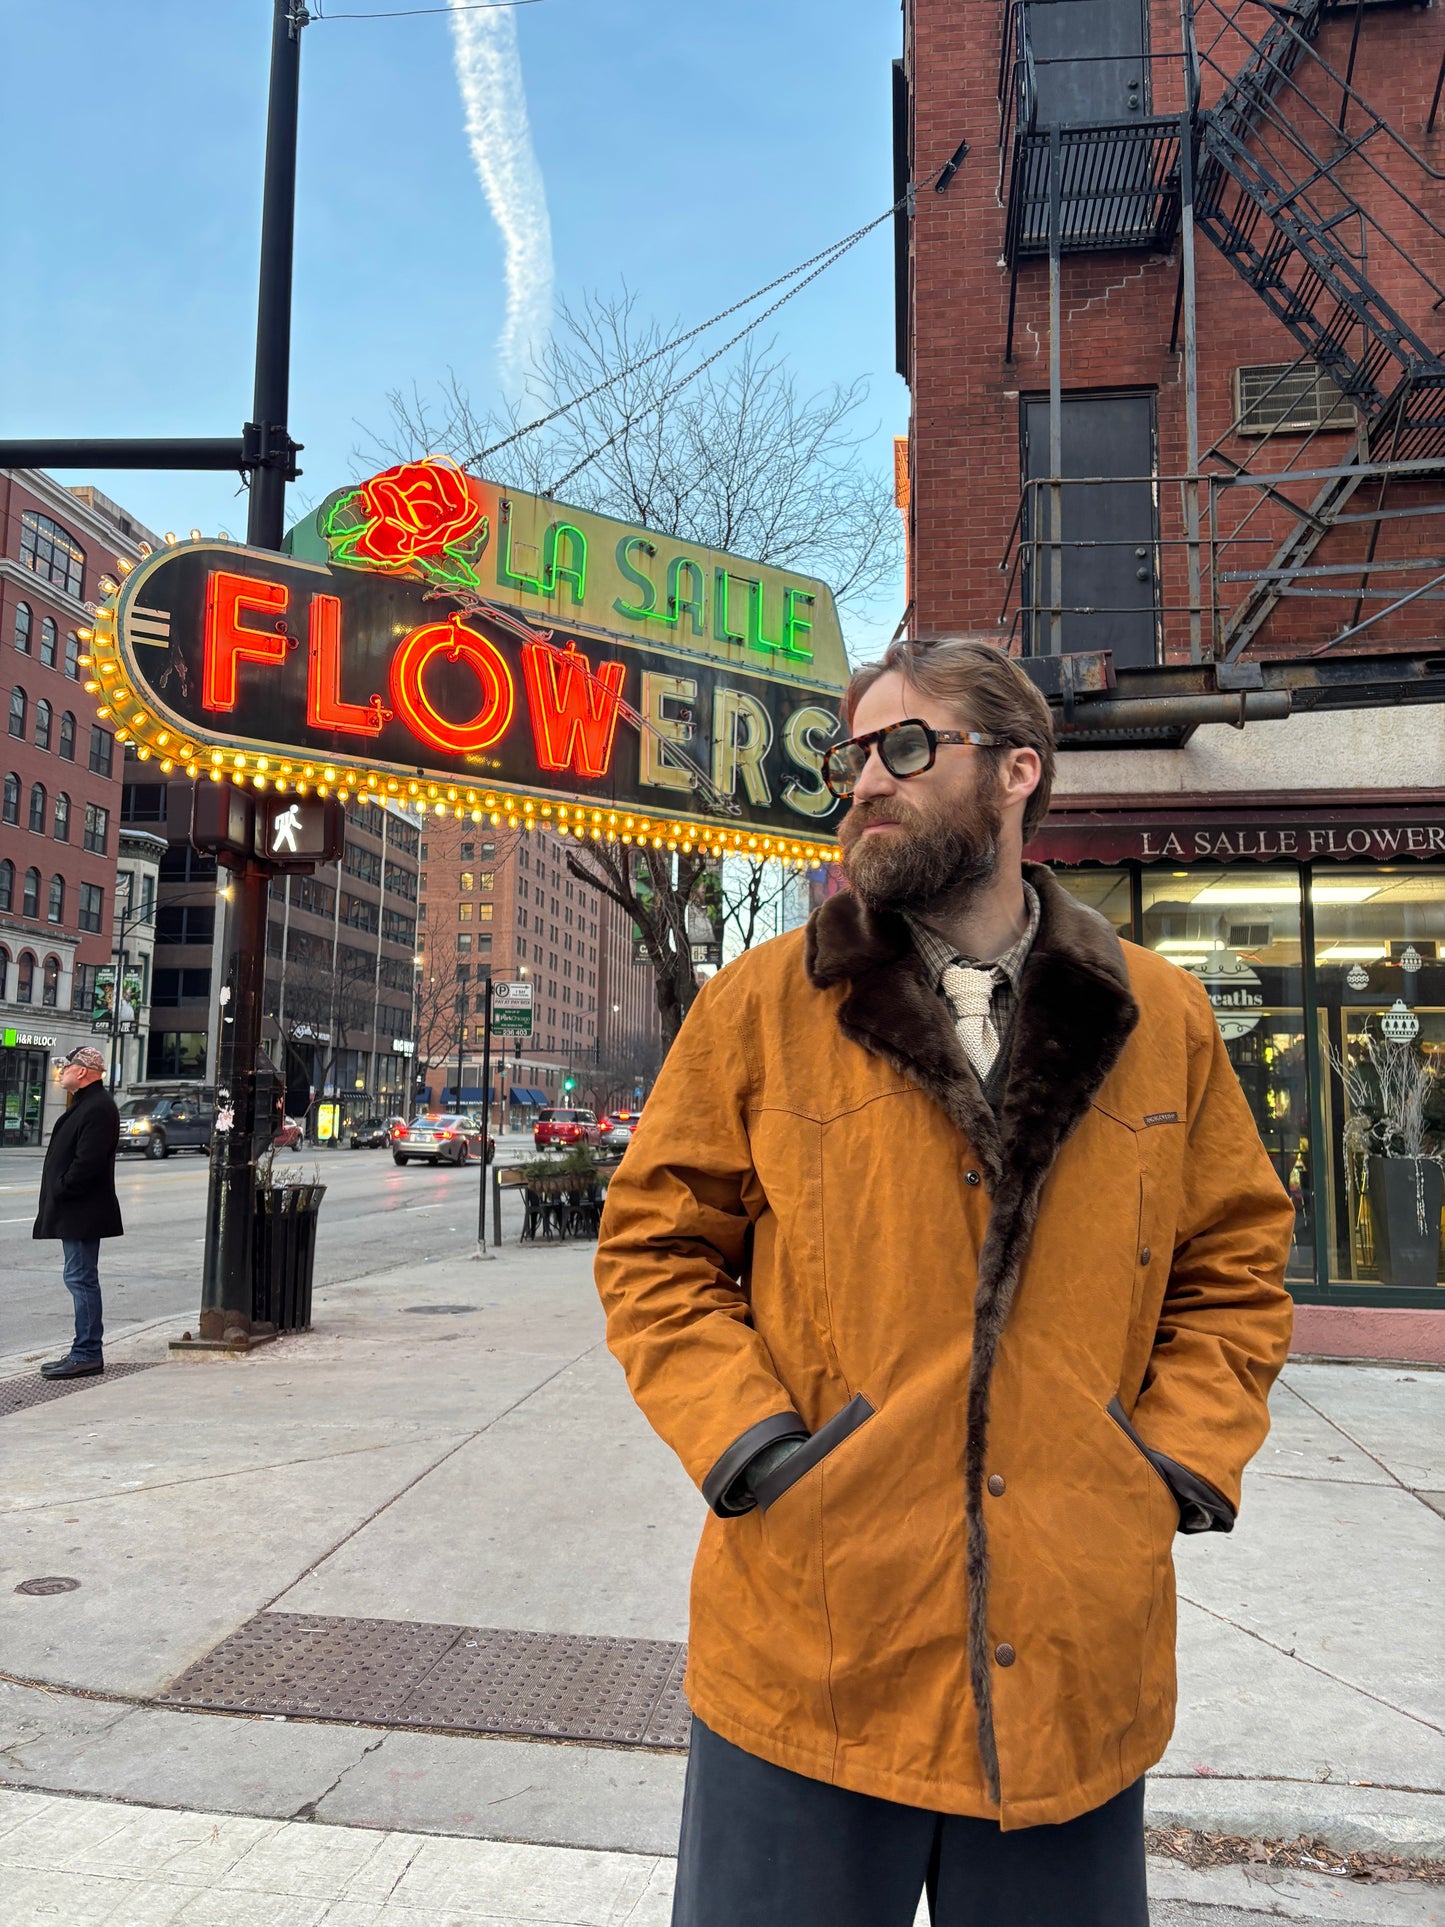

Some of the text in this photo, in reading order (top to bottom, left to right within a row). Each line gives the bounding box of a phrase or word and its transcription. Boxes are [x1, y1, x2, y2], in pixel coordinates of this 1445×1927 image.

[496, 496, 816, 666] LA SALLE
[202, 569, 844, 818] FLOWERS
[1140, 832, 1185, 856] LA
[1194, 830, 1299, 855] SALLE
[1208, 989, 1263, 1006] eaths
[16, 1033, 57, 1047] H&R BLOCK
